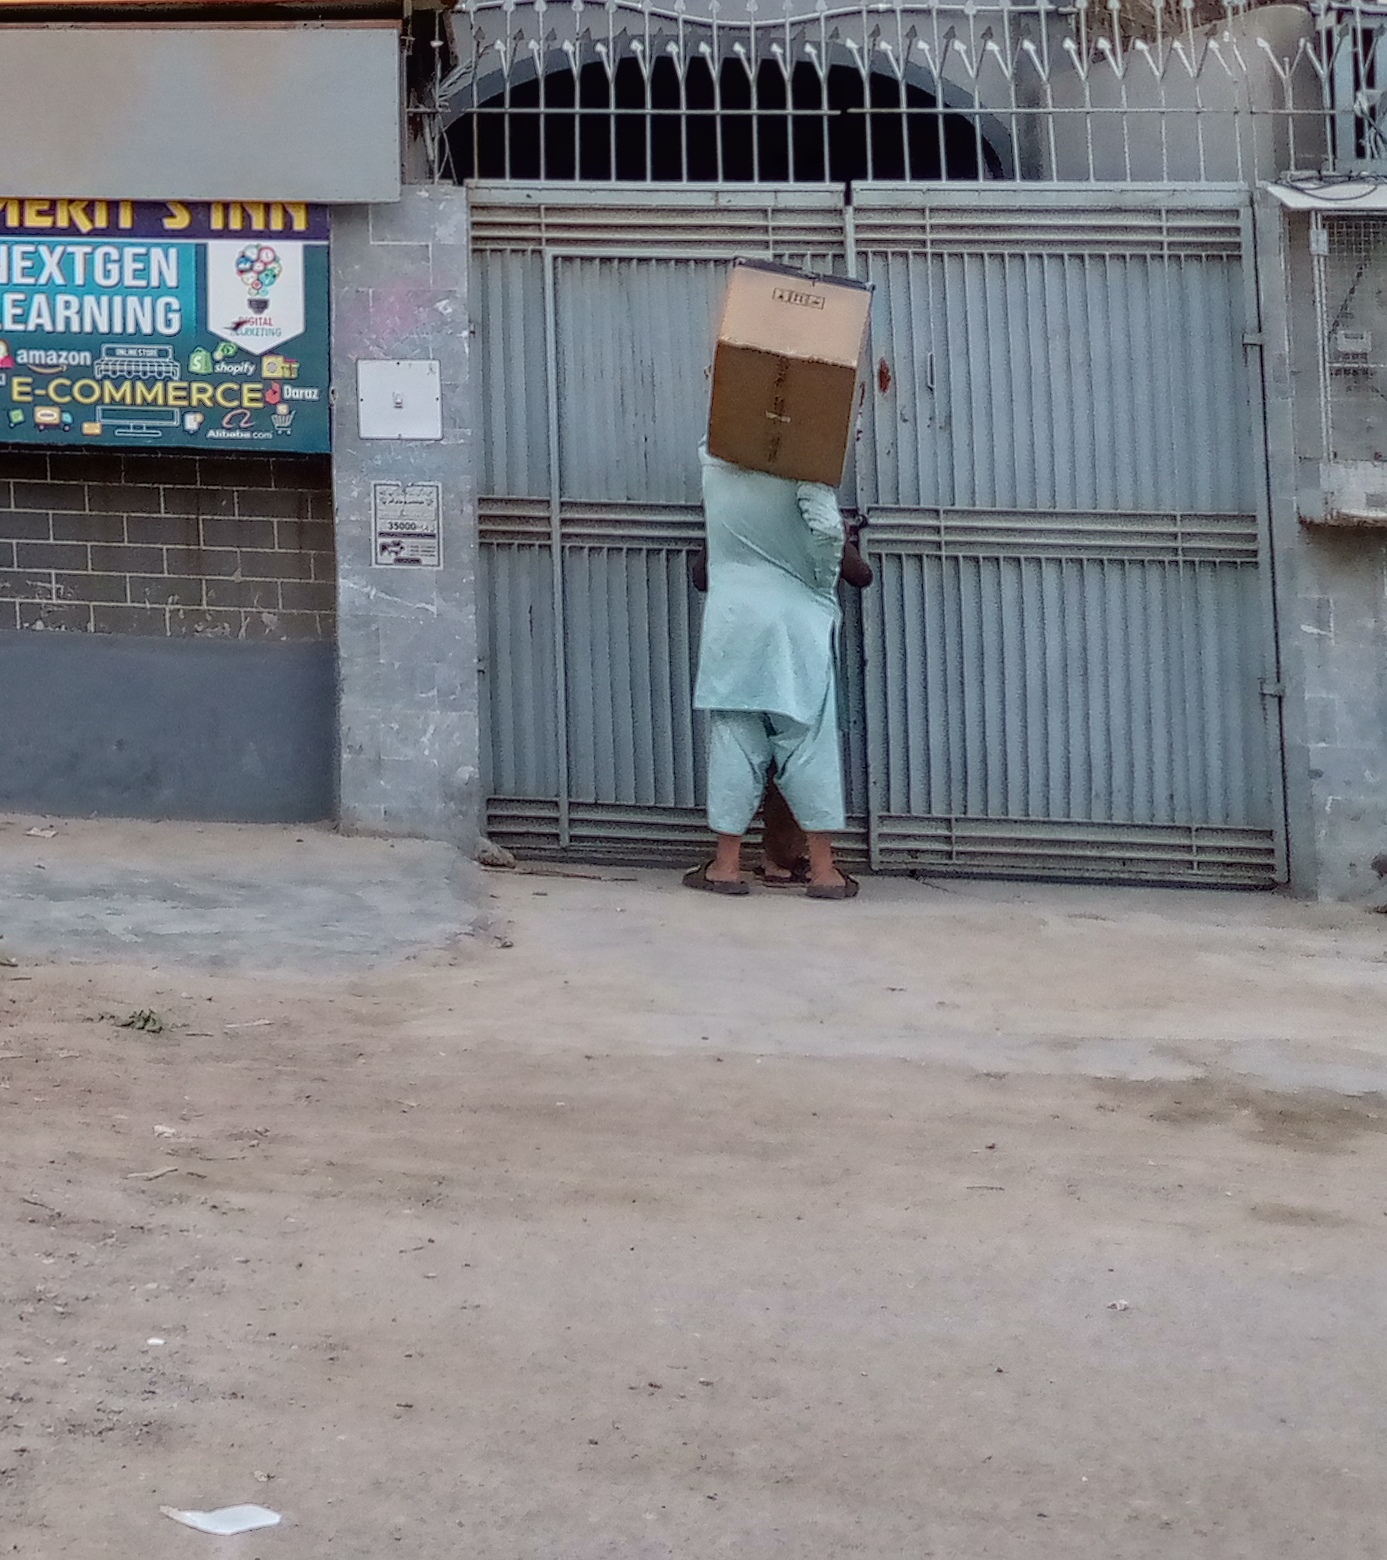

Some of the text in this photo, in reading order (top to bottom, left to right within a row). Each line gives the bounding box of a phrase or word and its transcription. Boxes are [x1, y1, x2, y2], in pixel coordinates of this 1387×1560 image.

[16, 349, 92, 365] amazon
[214, 360, 256, 377] shopify
[10, 376, 265, 409] E-COMMERCE
[283, 385, 320, 401] Daraz
[388, 521, 416, 531] 35000
